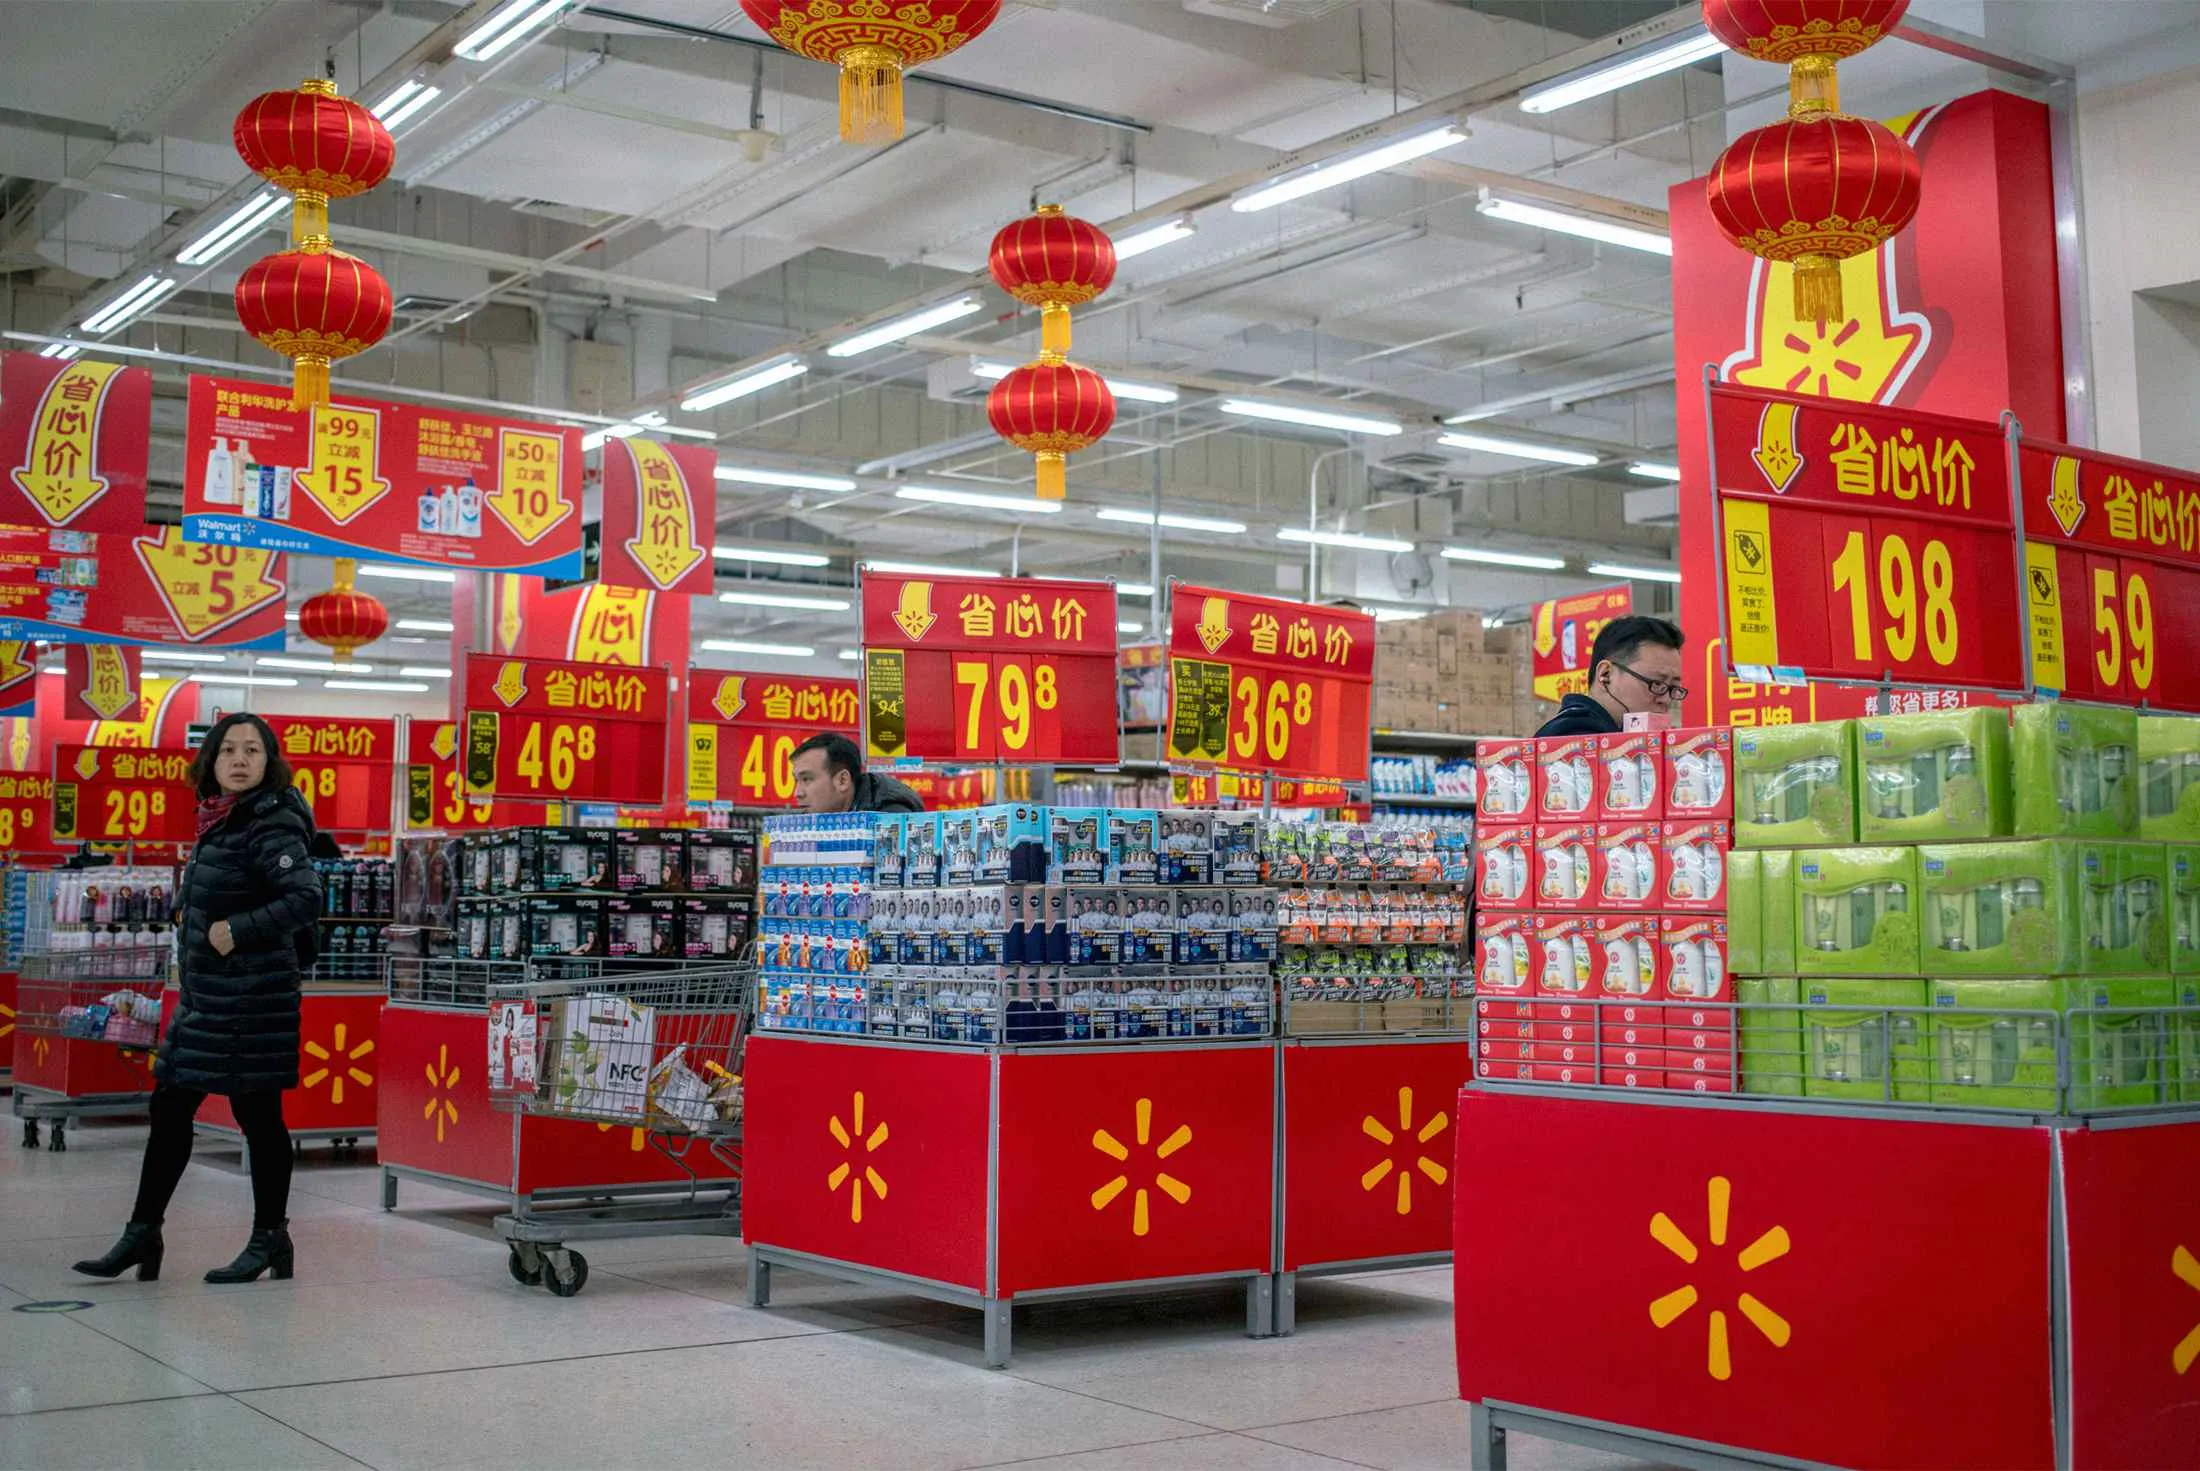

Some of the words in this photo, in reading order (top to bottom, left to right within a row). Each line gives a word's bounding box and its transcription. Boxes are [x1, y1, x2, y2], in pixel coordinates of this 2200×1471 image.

[43, 374, 98, 479] 省心价
[327, 443, 361, 459] 立减
[1829, 422, 1976, 510] 省心价
[324, 464, 362, 496] 15
[515, 467, 546, 482] 立减
[512, 488, 549, 517] 10
[644, 457, 684, 549] 省心价
[2103, 475, 2200, 553] 省心价
[197, 519, 241, 532] Walmart
[959, 593, 1088, 641] 省心价
[1832, 531, 1958, 666] 198
[1249, 613, 1353, 666] 省心价
[2094, 568, 2154, 690] 59
[544, 669, 647, 713] 省心价
[762, 684, 860, 724] 省心价
[283, 723, 376, 757] 省心价
[113, 753, 190, 780] 省心价
[609, 1062, 644, 1082] NFC
